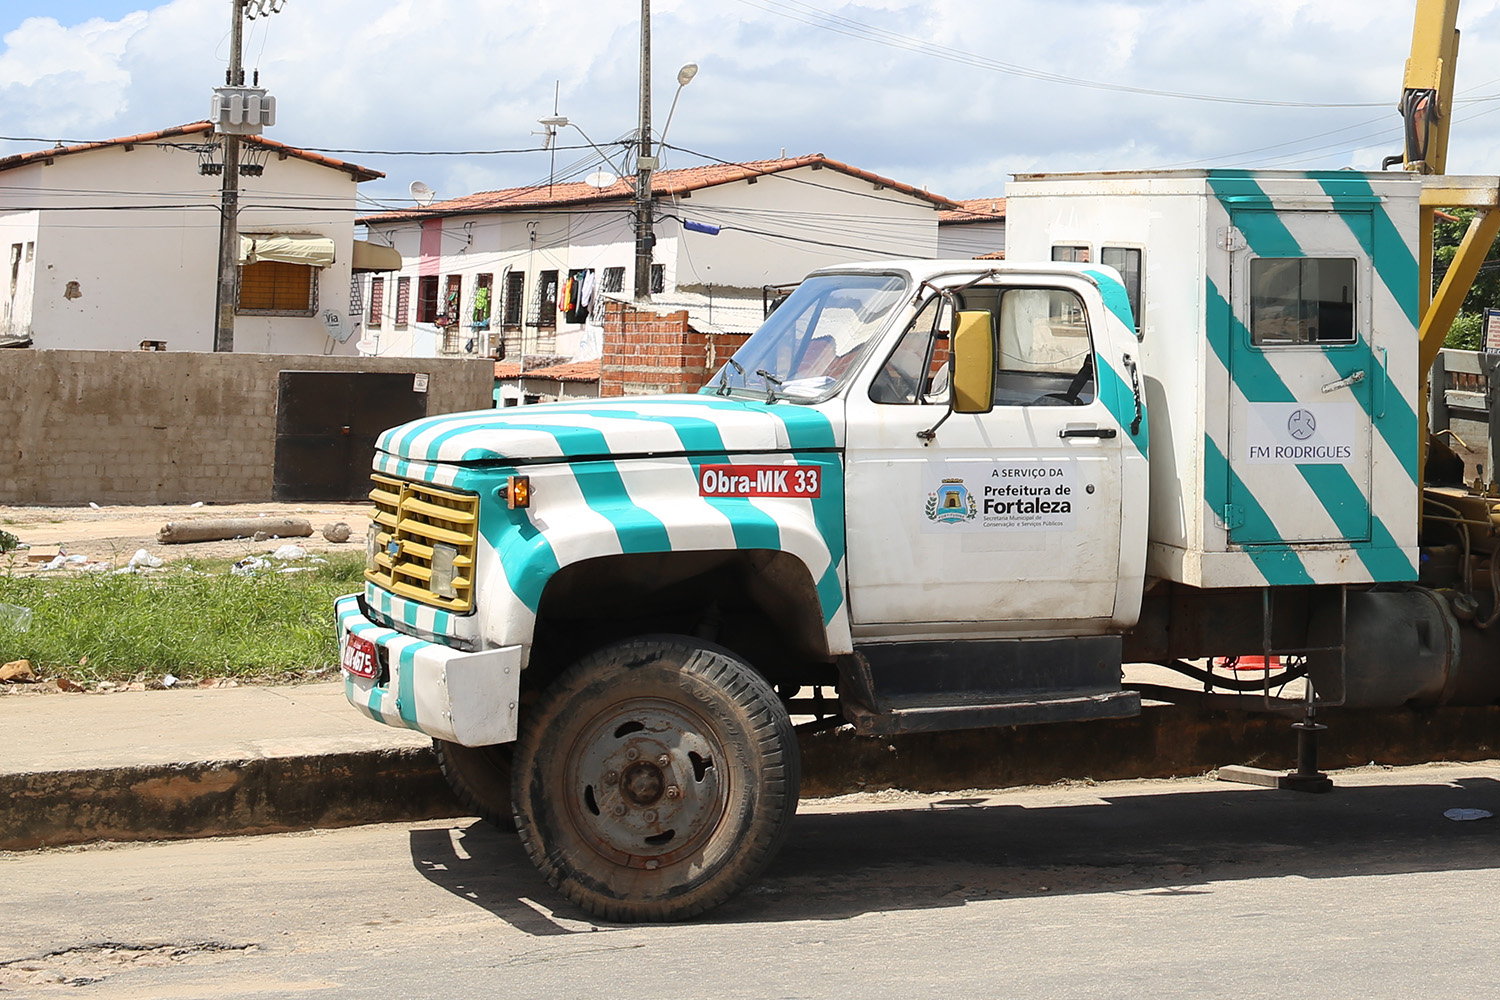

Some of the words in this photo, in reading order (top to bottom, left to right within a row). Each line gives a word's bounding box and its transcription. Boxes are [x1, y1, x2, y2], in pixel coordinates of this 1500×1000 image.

[1250, 446, 1270, 458] FM
[1275, 446, 1351, 459] RODRIGUES
[991, 469, 999, 478] A
[1001, 468, 1046, 479] SERVIÇO
[1049, 468, 1064, 477] DA
[702, 470, 789, 493] Obra-MK
[794, 470, 818, 493] 33
[984, 484, 1051, 497] Prefeitura
[1055, 484, 1071, 496] de
[983, 497, 1071, 515] Fortaleza
